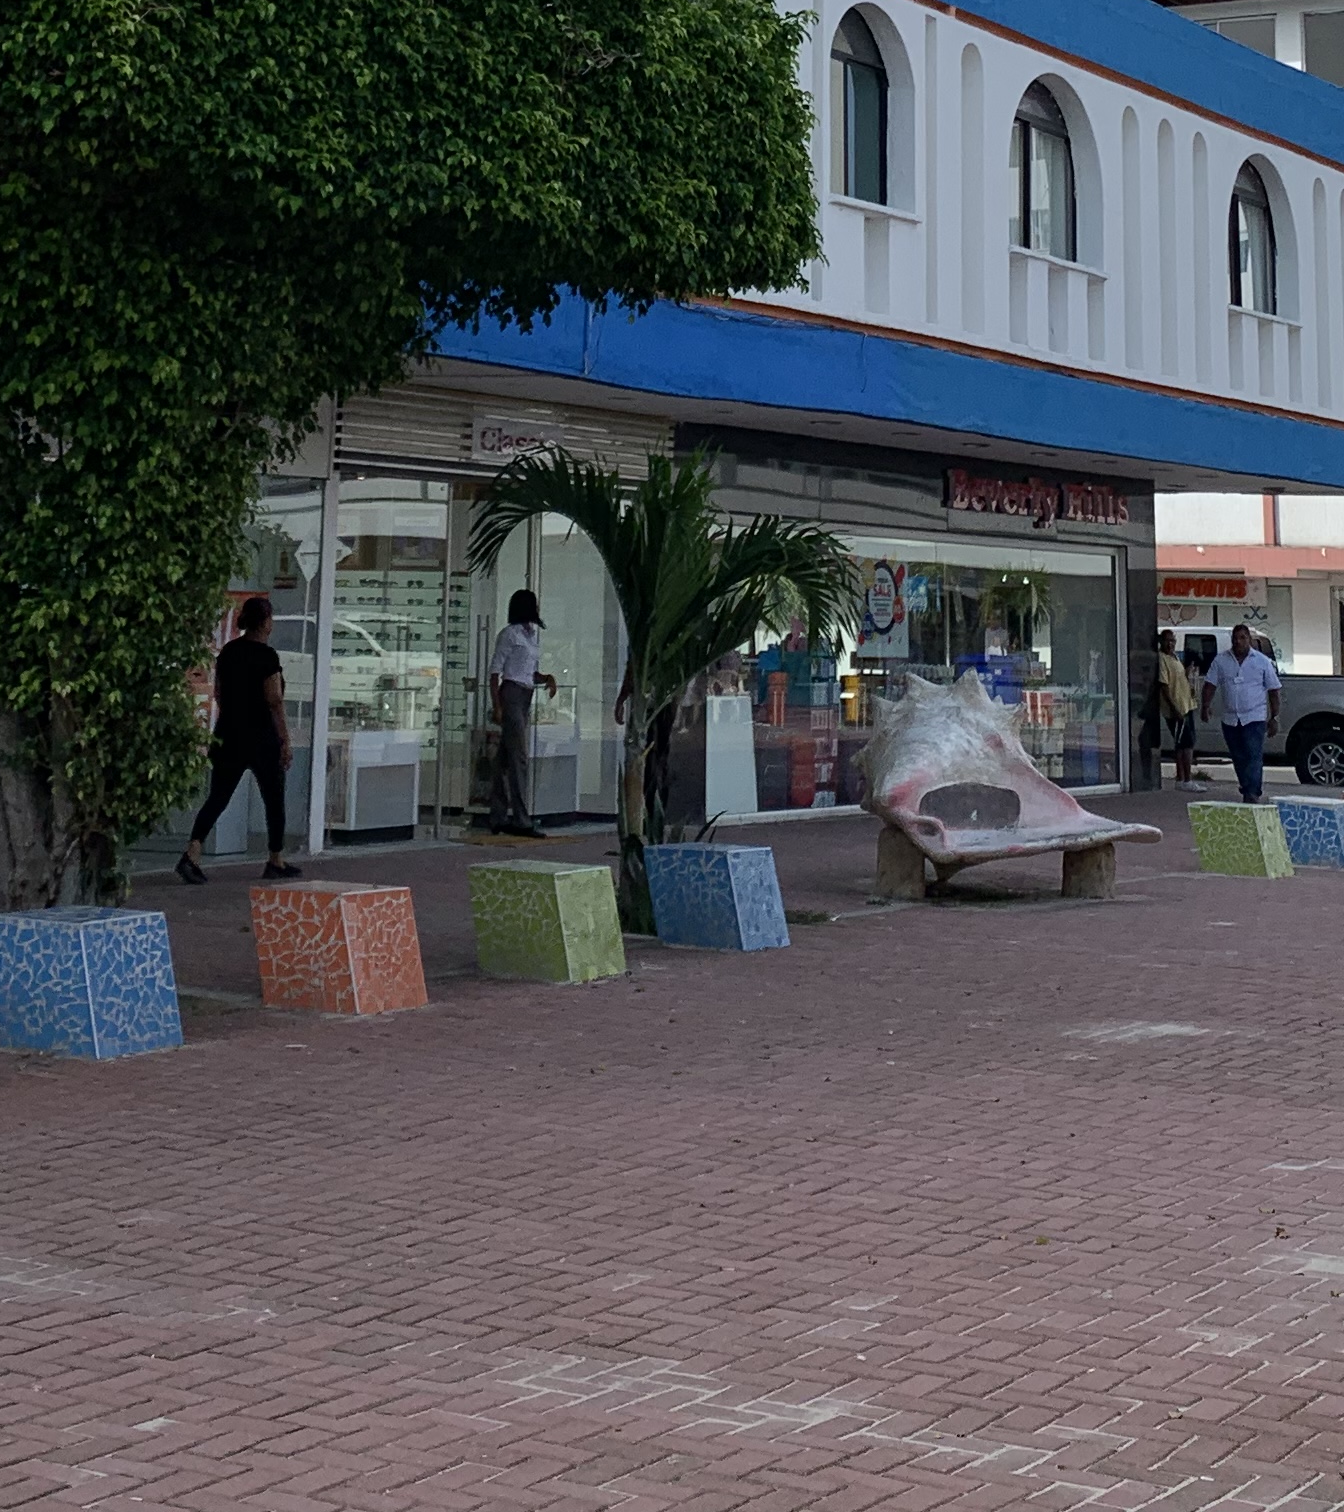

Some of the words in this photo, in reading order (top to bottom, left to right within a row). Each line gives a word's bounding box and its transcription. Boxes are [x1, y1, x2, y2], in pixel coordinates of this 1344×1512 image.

[943, 468, 1058, 529] Beverly
[1058, 483, 1130, 525] Hills
[873, 583, 892, 598] SALE
